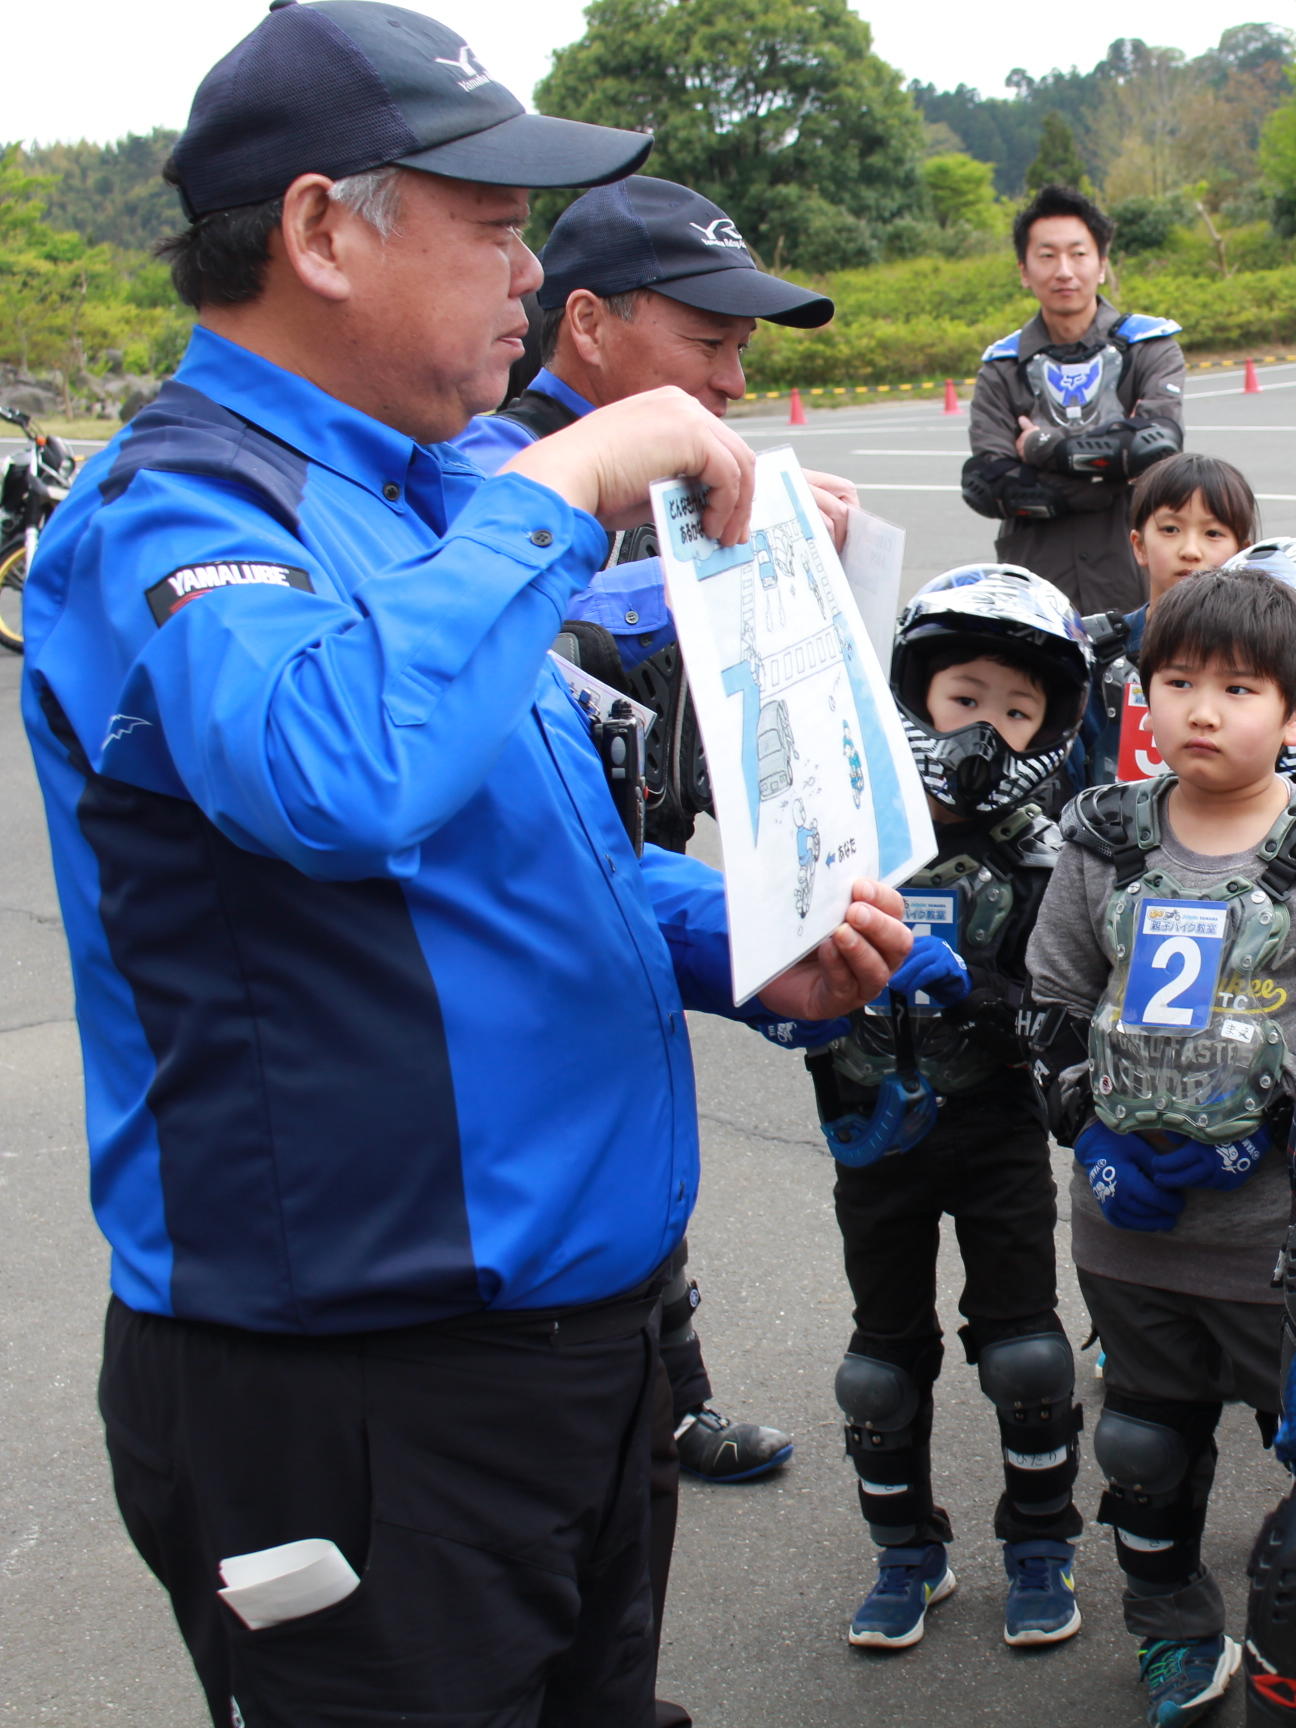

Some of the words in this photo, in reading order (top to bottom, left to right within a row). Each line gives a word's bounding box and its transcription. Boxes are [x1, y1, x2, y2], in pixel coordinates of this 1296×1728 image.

[168, 563, 290, 597] YAMALUBE
[838, 837, 857, 863] あなた
[1142, 936, 1202, 1025] 2
